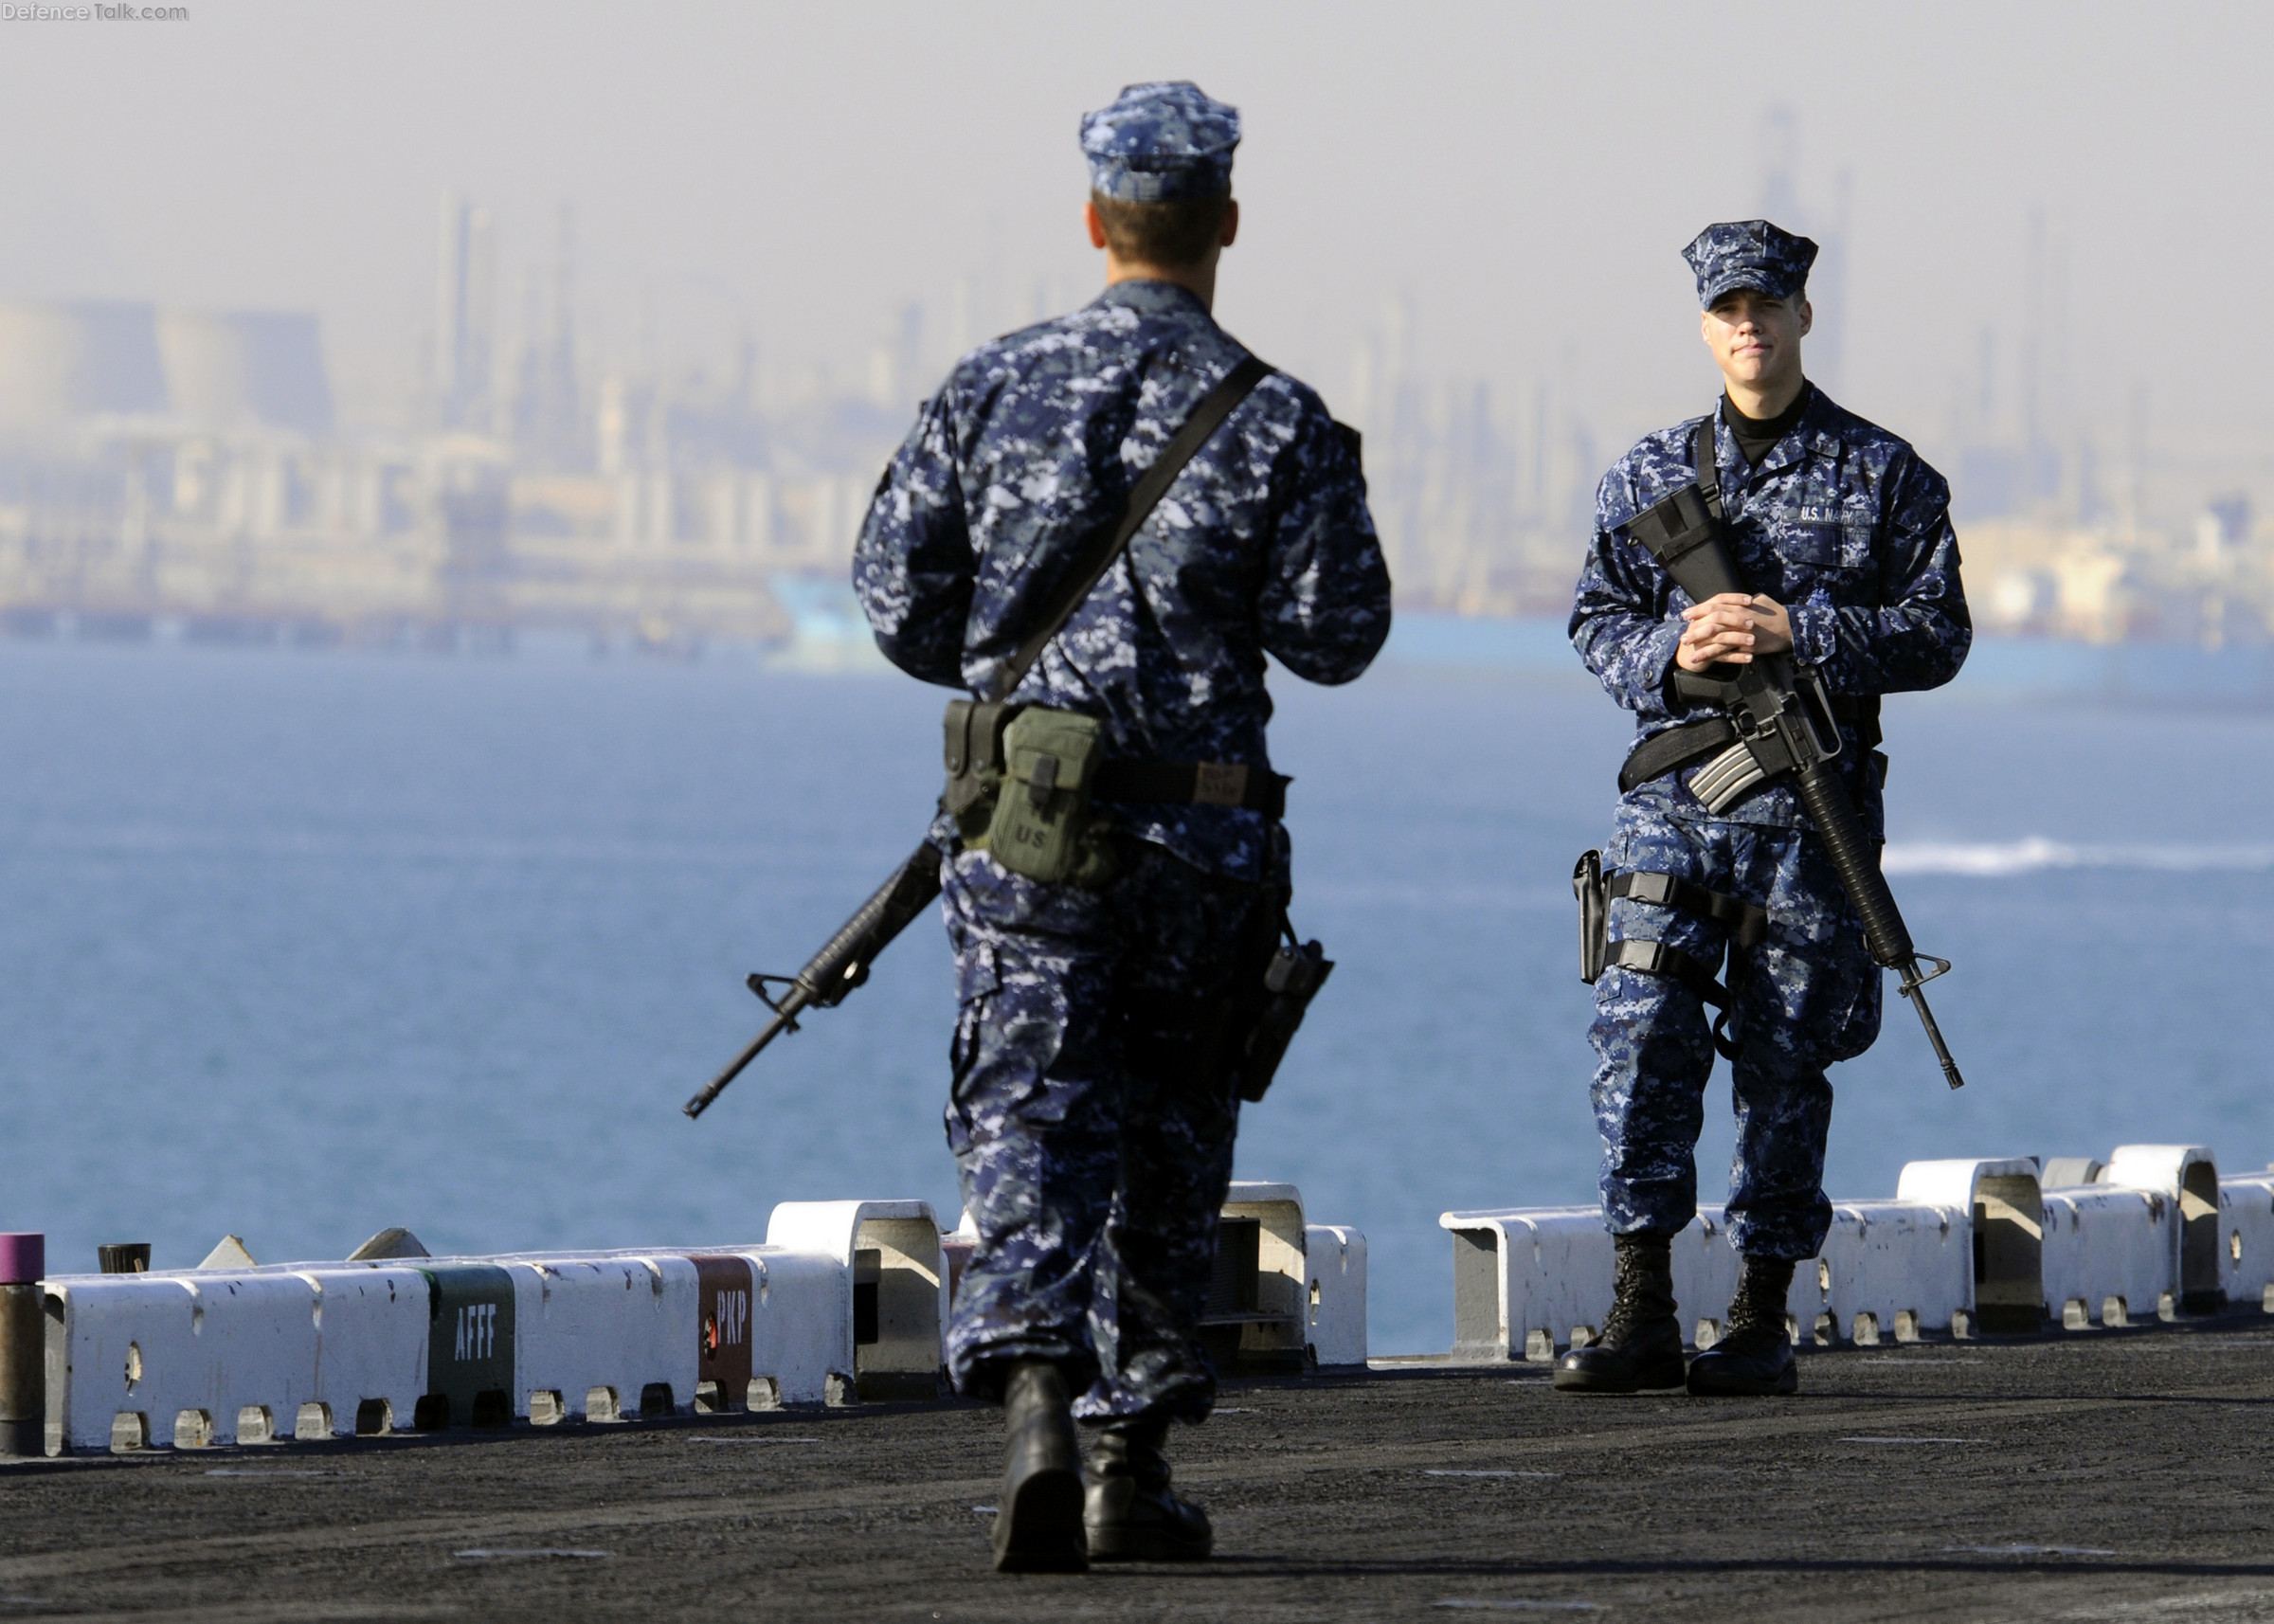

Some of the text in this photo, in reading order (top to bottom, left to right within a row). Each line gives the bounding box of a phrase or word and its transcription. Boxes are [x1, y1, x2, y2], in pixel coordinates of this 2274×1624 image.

[1800, 506, 1820, 521] U.S.
[1015, 822, 1047, 850] US
[454, 1303, 496, 1362] AFFF
[717, 1290, 747, 1345] PKP
